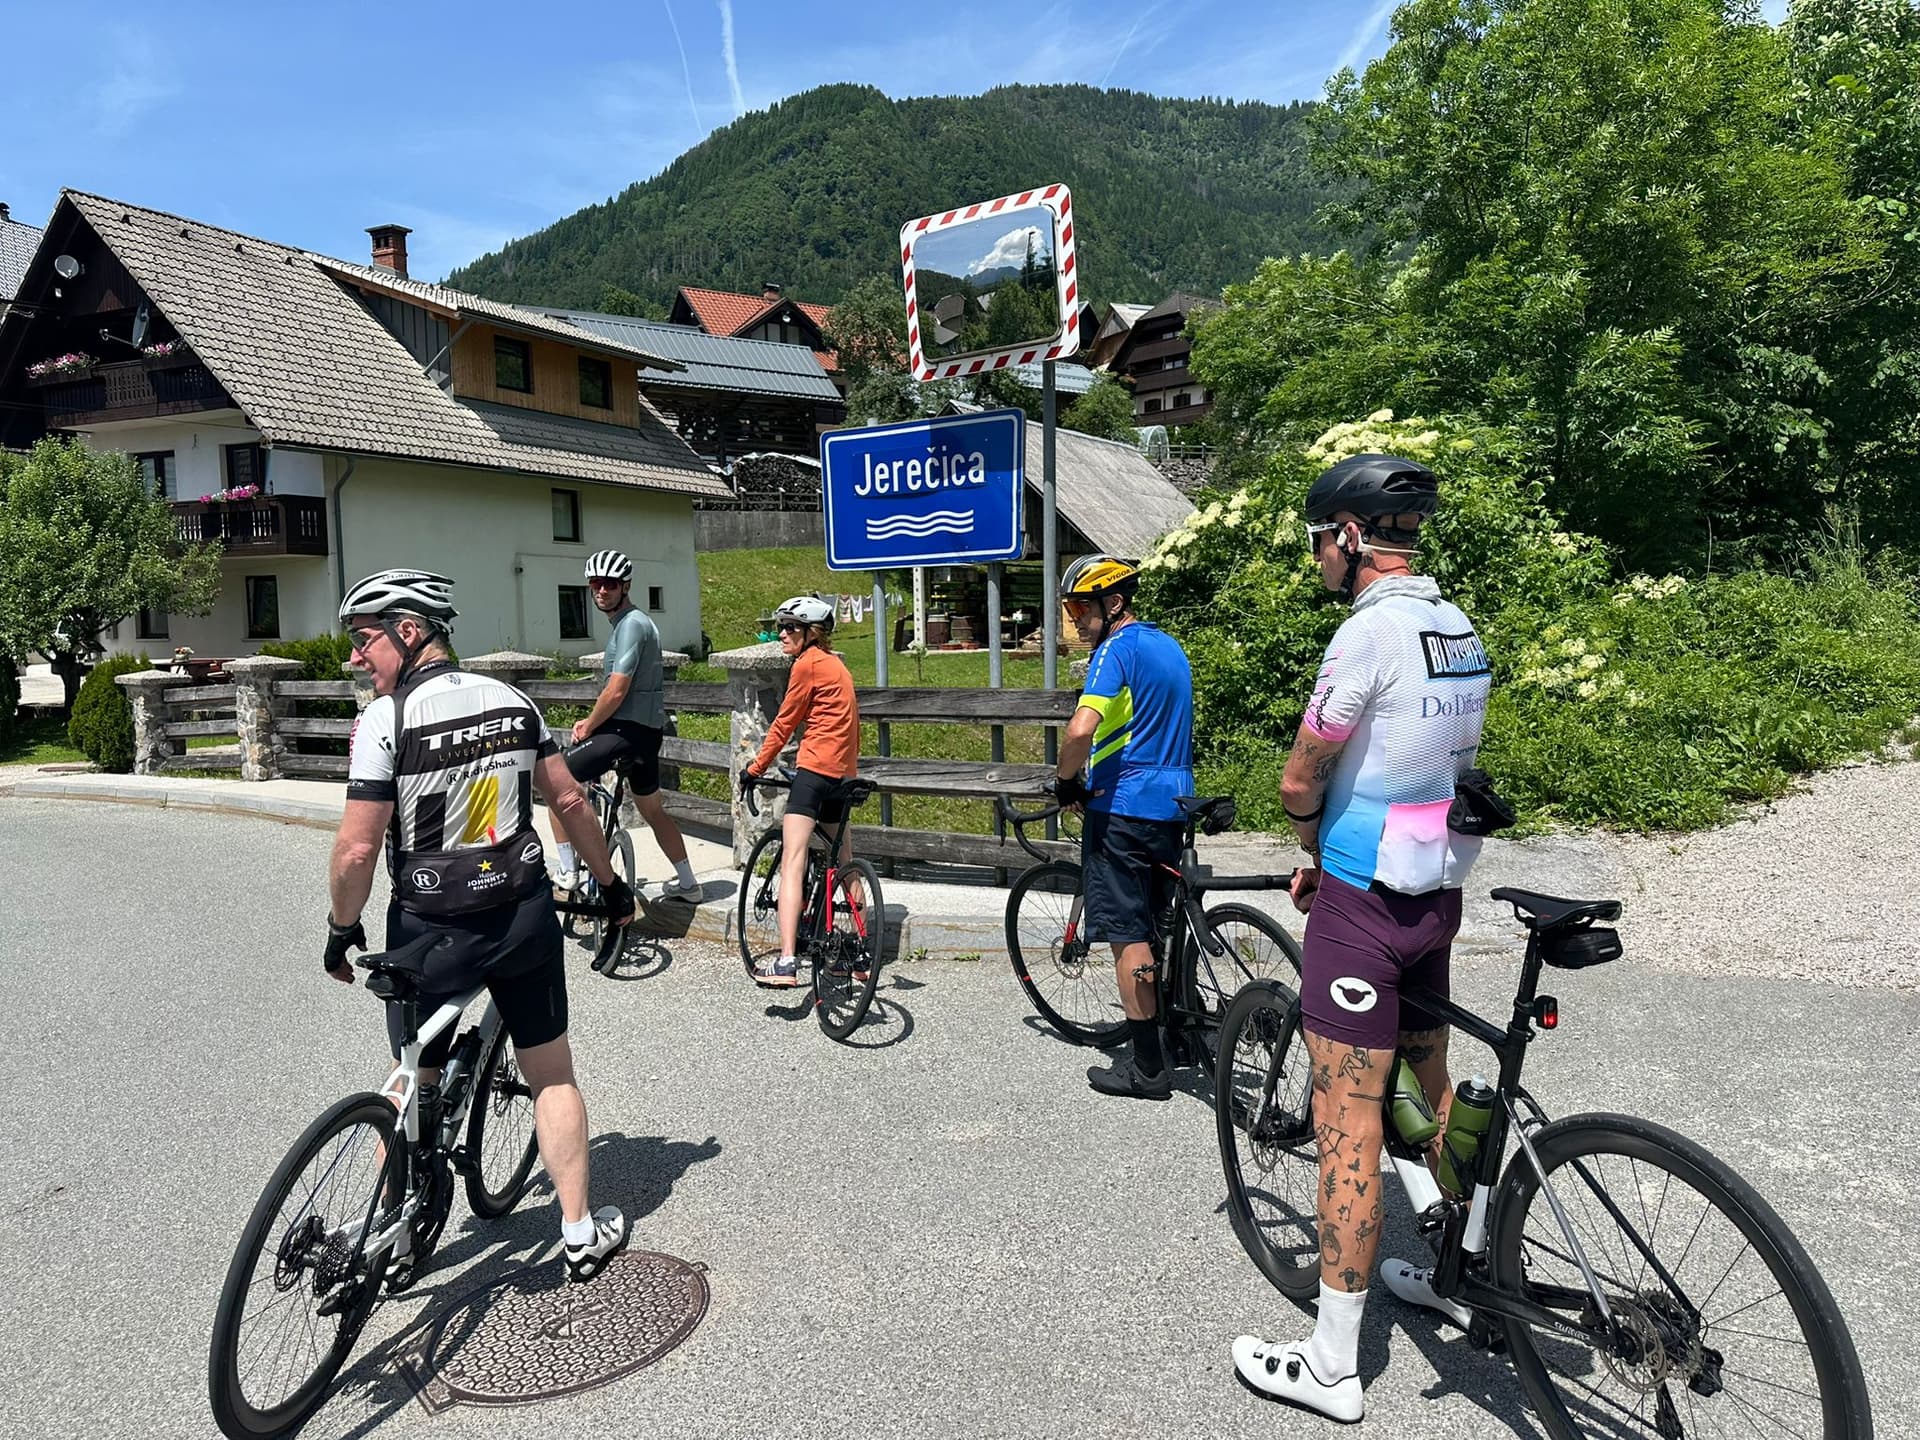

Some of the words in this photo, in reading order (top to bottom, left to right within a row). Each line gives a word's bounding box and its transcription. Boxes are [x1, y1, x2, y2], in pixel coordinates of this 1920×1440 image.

[854, 445, 985, 496] Jerečica
[1422, 695, 1452, 718] Do
[420, 717, 526, 751] TREK
[439, 736, 518, 762] LIVESRONG
